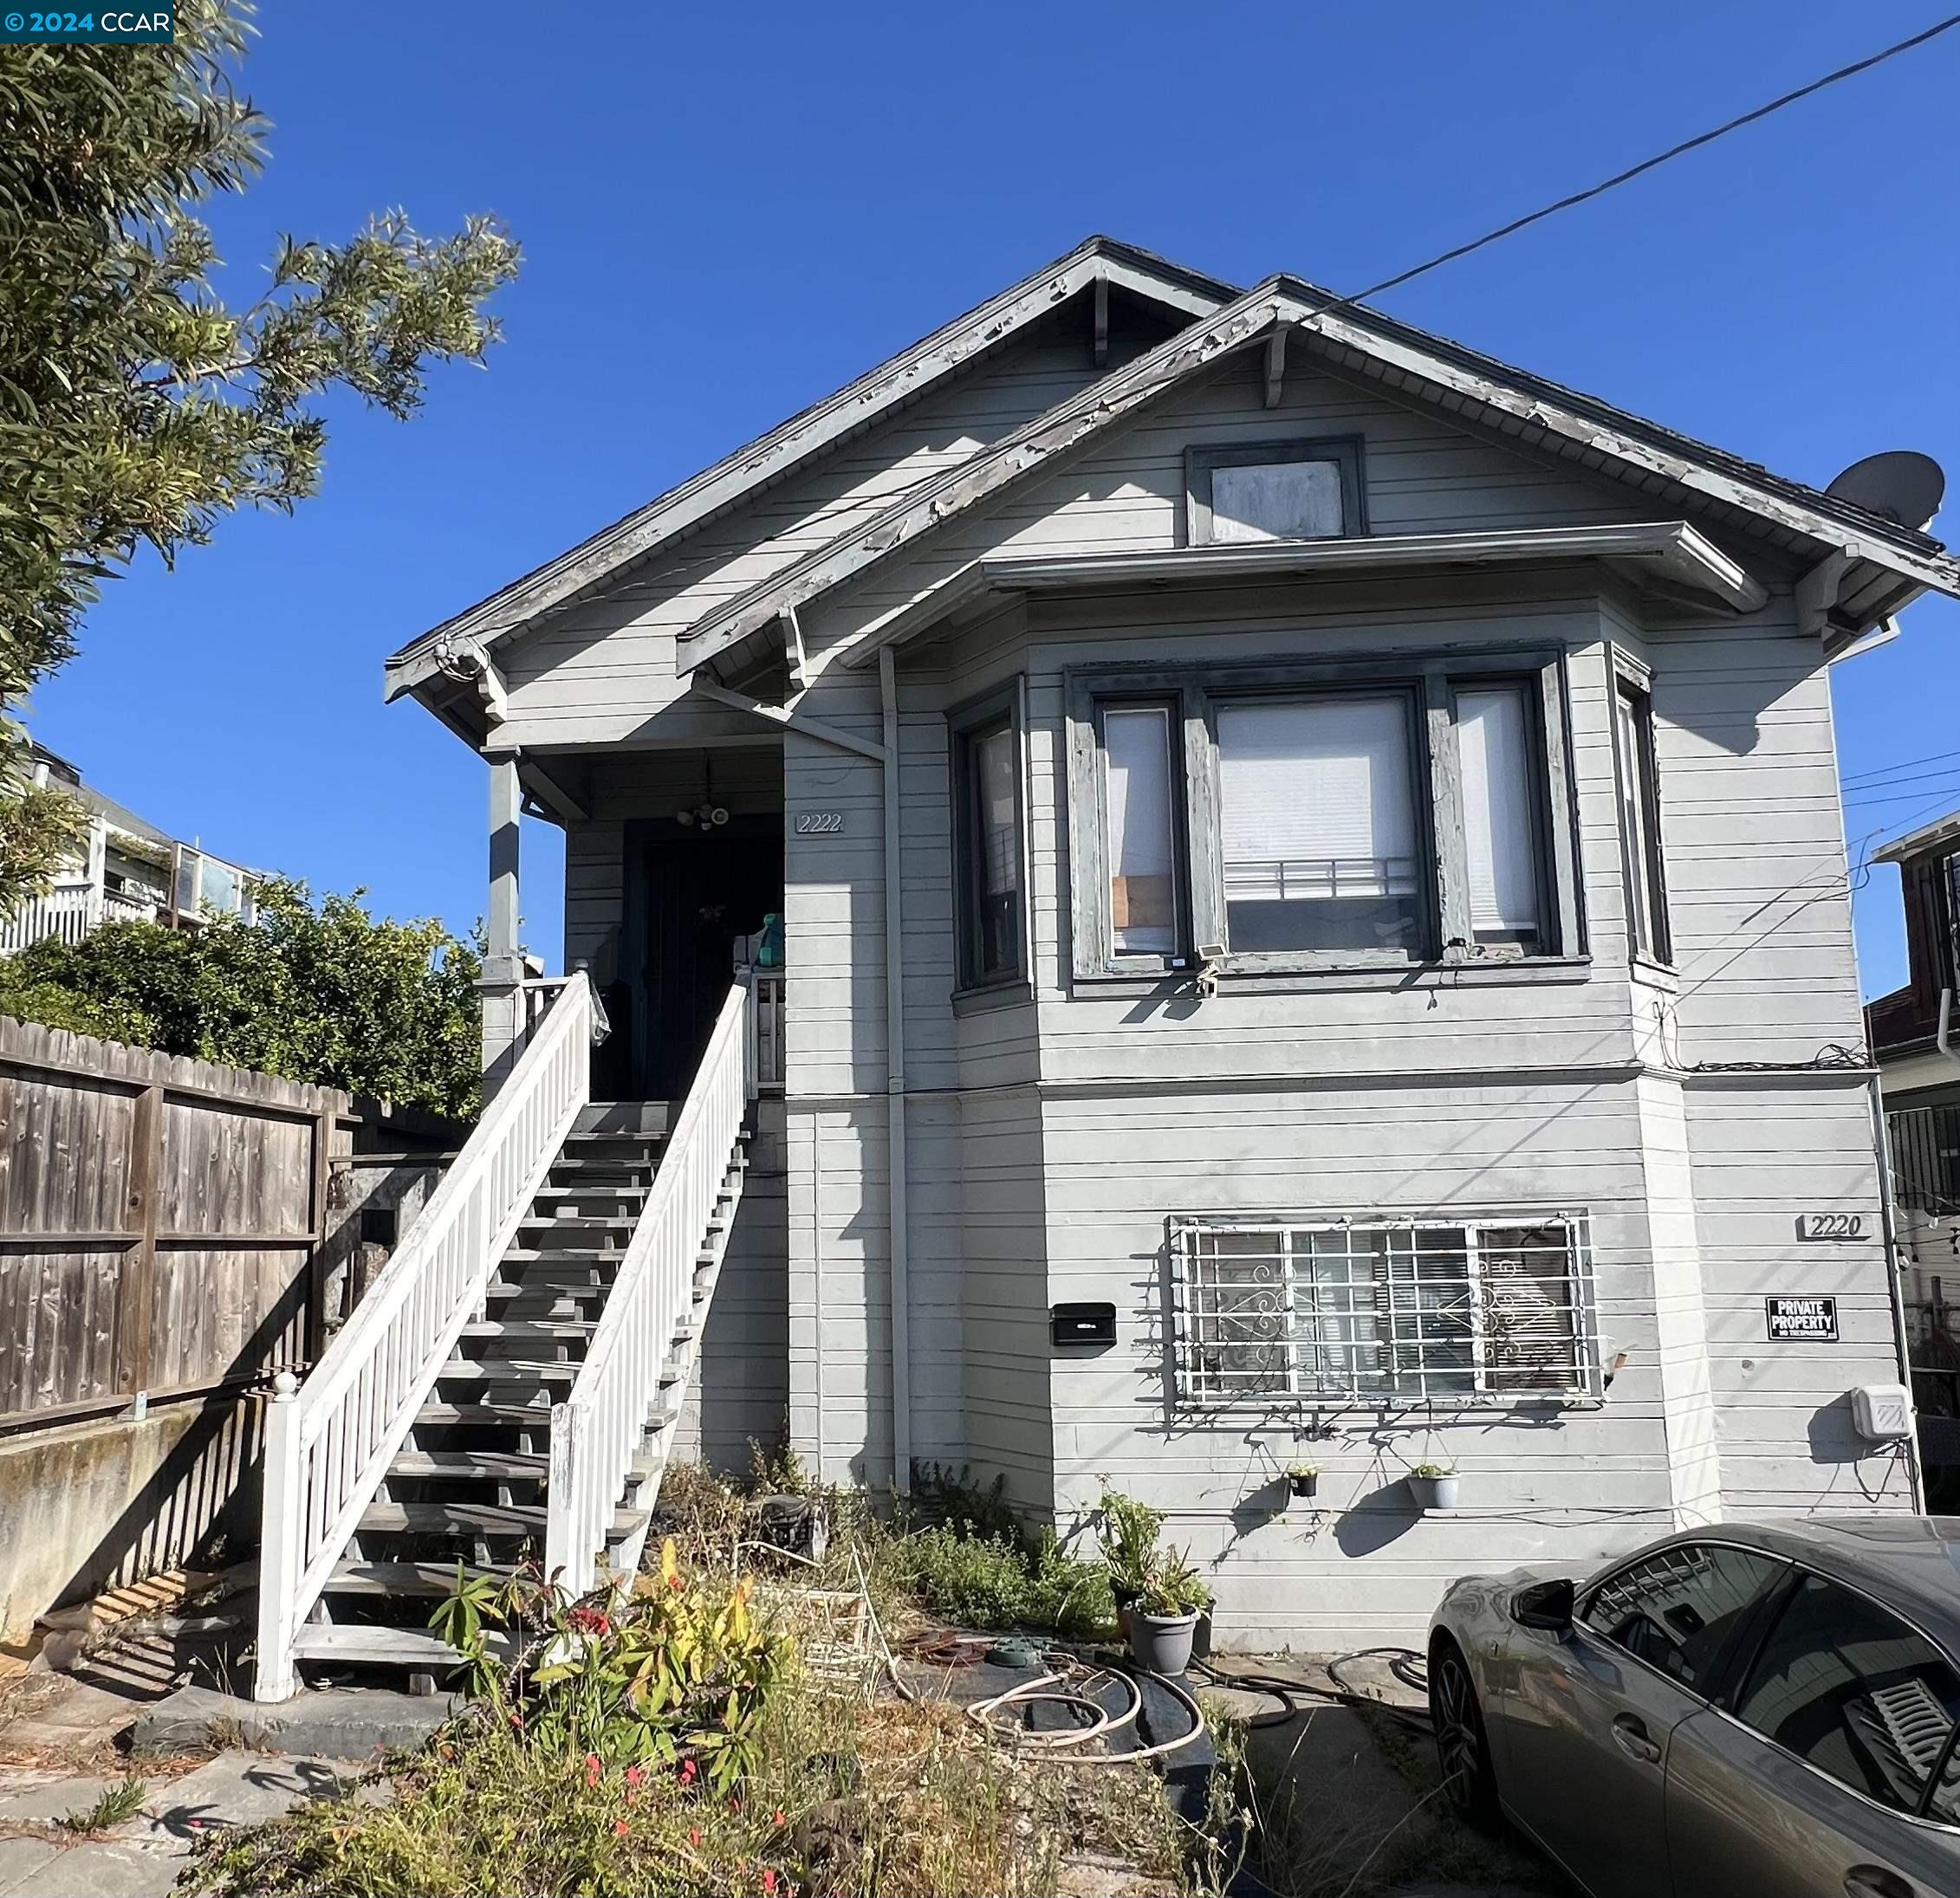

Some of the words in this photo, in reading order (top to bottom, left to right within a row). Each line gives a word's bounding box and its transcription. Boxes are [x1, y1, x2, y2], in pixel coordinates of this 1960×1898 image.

[798, 813, 842, 832] 2222
[1811, 1215, 1861, 1235] 2220
[1777, 1300, 1825, 1315] PRIVATE
[1771, 1315, 1832, 1330] PROPERTY
